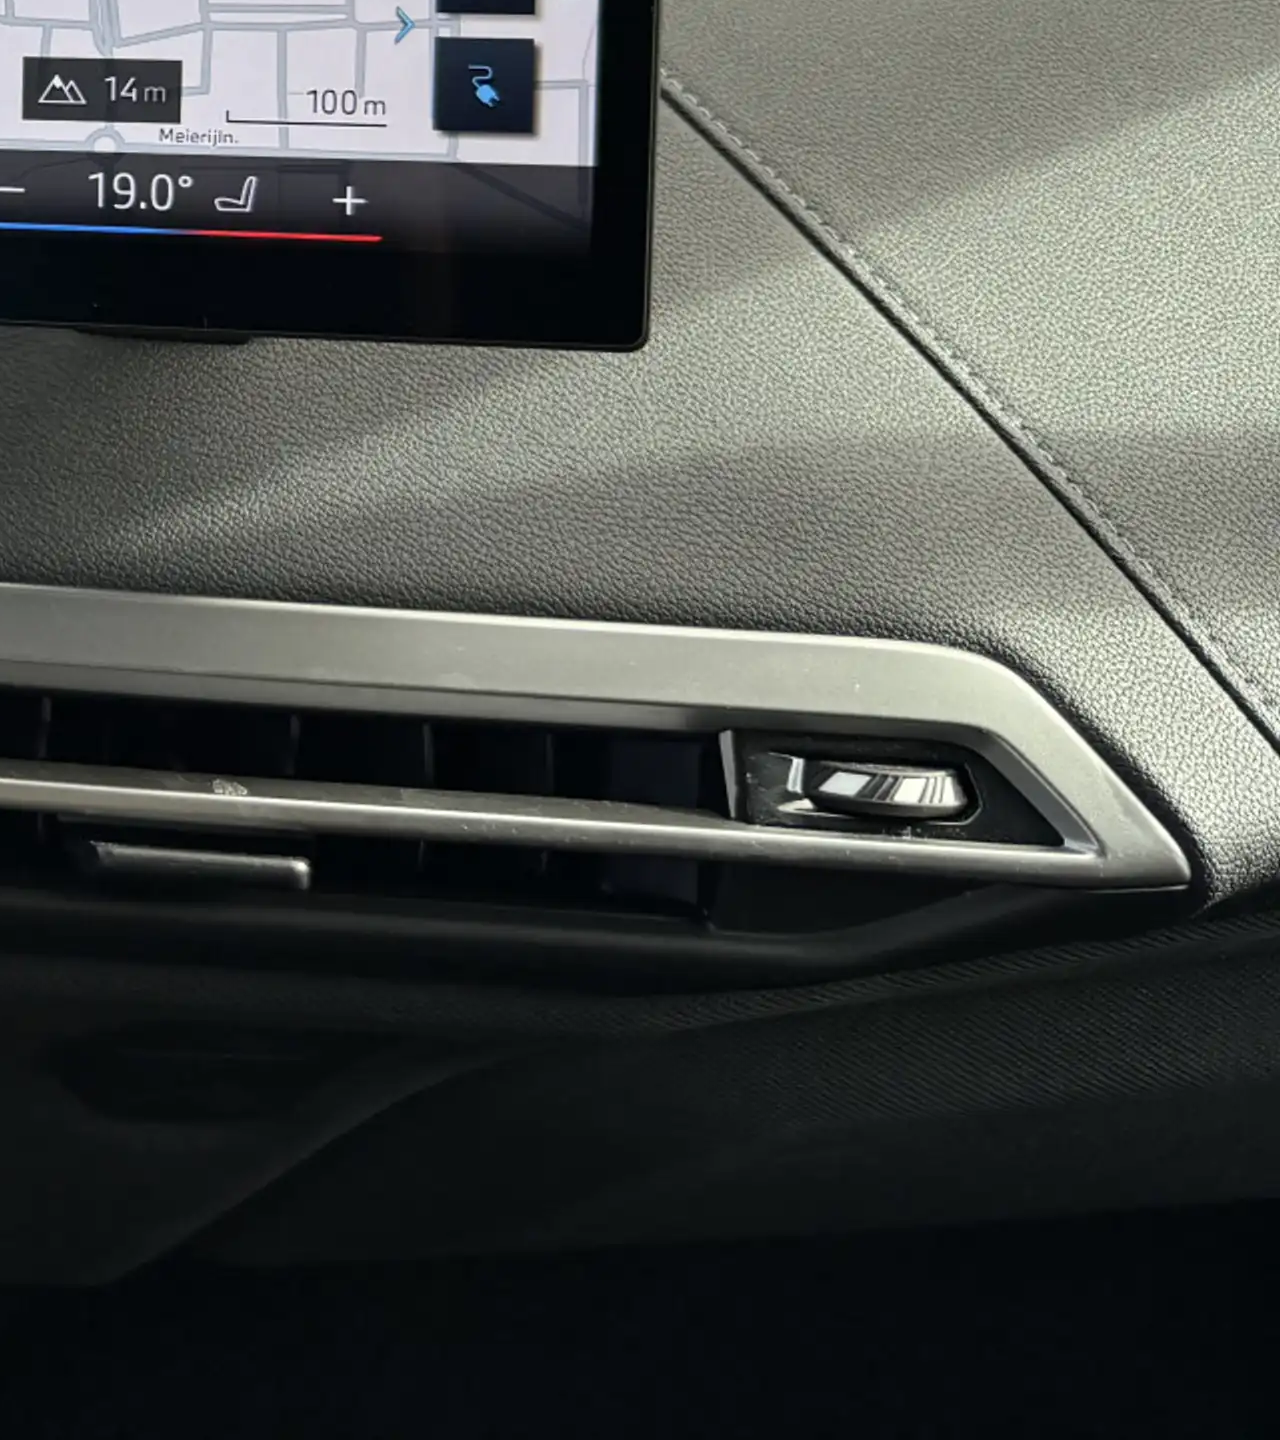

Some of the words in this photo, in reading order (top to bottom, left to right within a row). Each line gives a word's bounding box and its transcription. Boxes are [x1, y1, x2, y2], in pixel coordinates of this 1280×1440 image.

[104, 76, 138, 103] 14
[142, 85, 167, 103] m
[306, 89, 359, 116] 100
[362, 98, 388, 117] m
[87, 171, 195, 212] 19.0°
